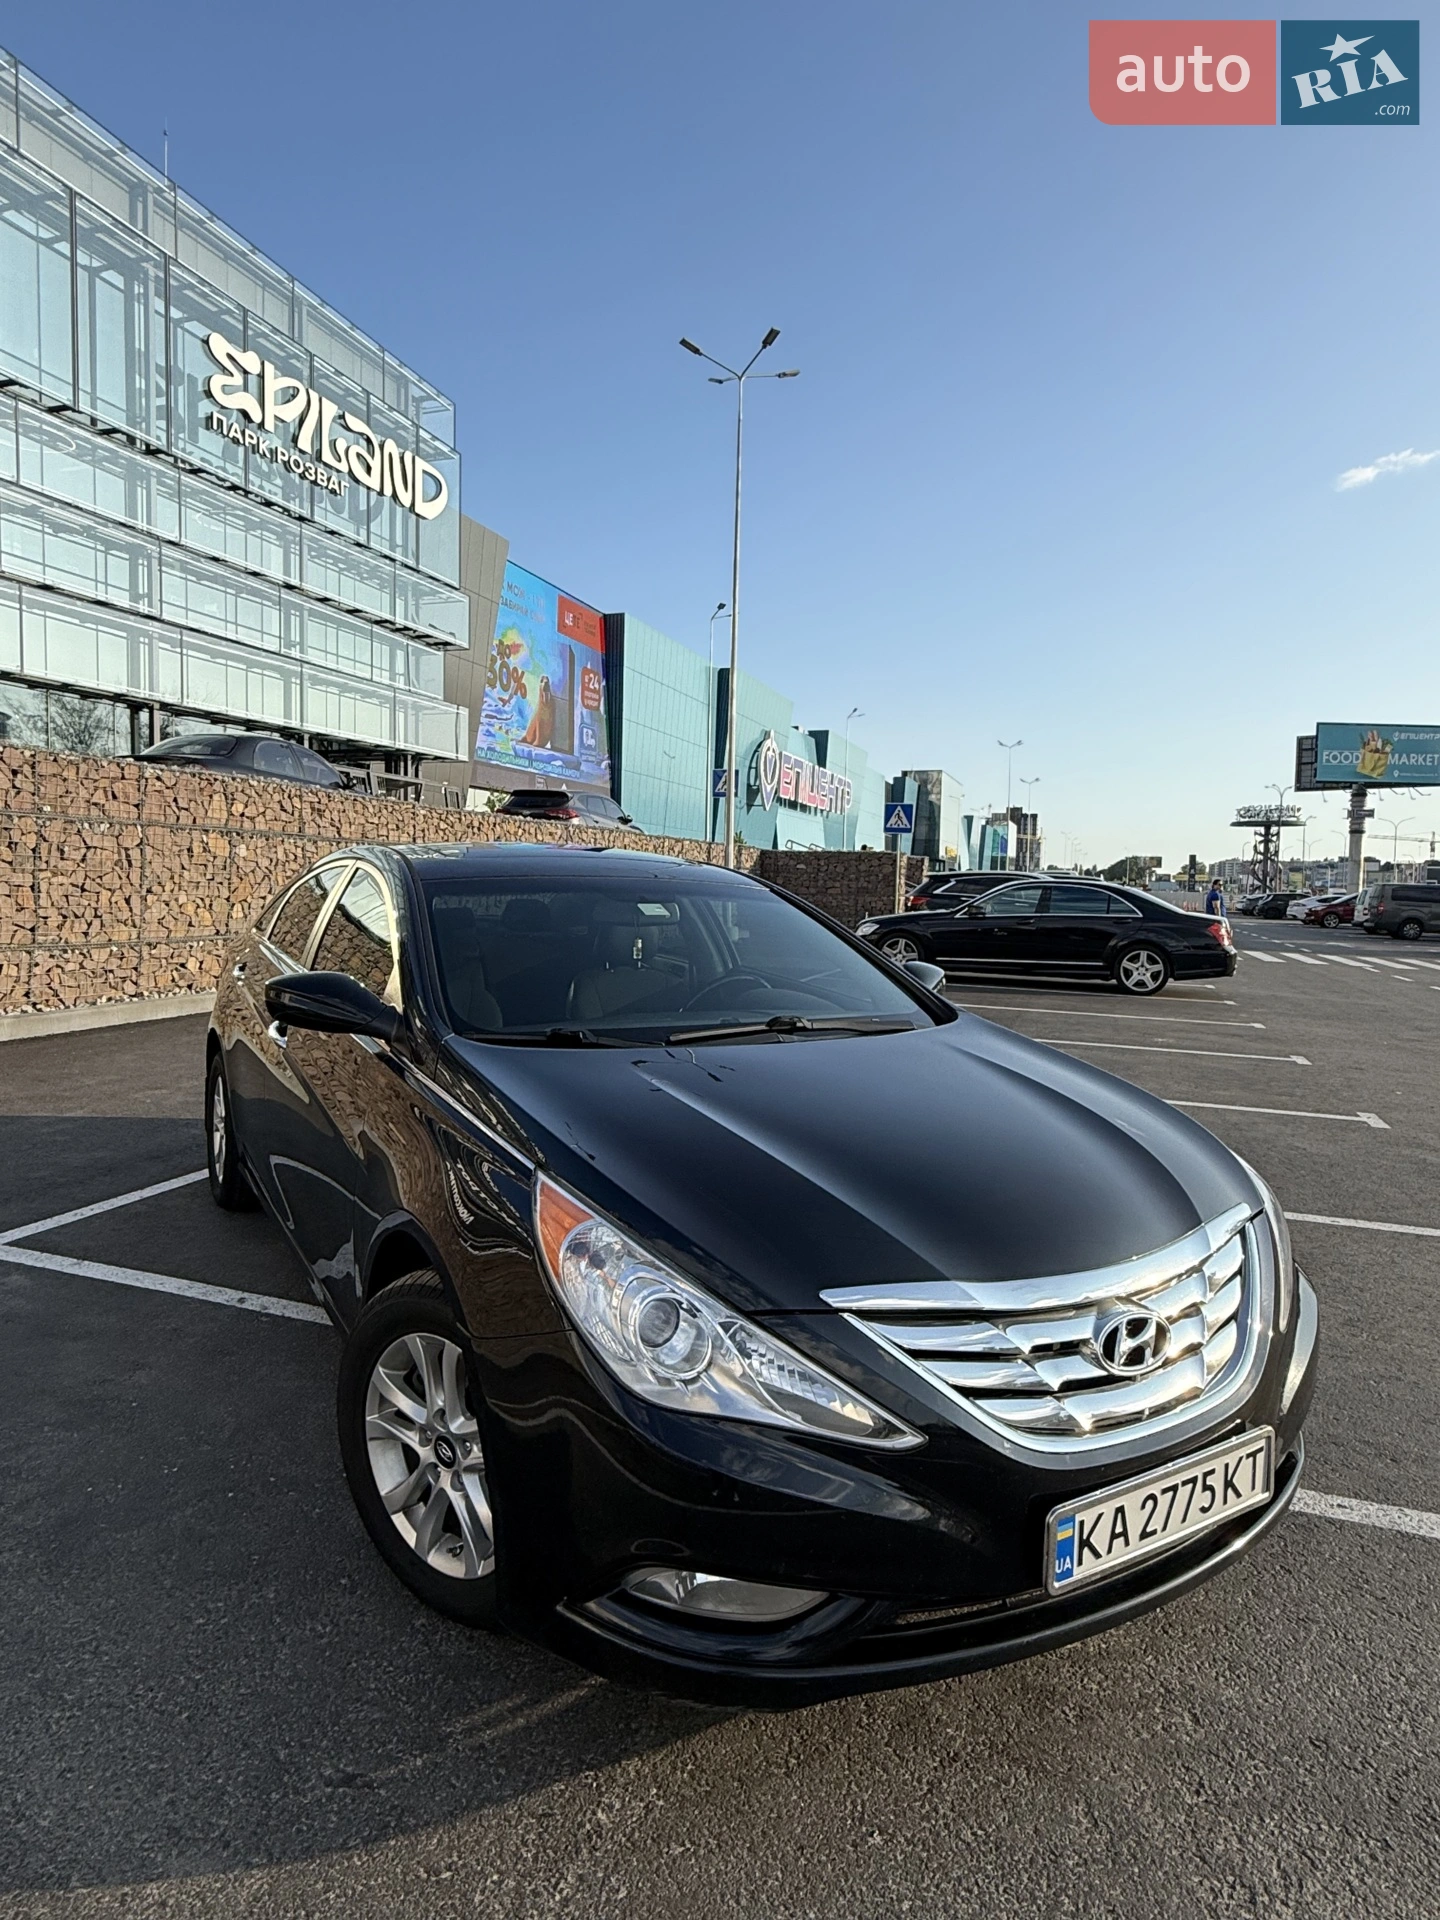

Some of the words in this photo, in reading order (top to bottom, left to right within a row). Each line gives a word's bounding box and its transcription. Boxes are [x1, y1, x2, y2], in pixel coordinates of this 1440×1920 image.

[211, 411, 271, 459] ПАРК
[277, 447, 350, 497] РОЗВАГ
[1322, 752, 1361, 765] FOOD
[1387, 753, 1440, 766] MARKET
[1077, 1504, 1131, 1567] KA
[1138, 1468, 1216, 1542] 2775
[1223, 1447, 1265, 1505] KT
[1055, 1556, 1072, 1574] UA
